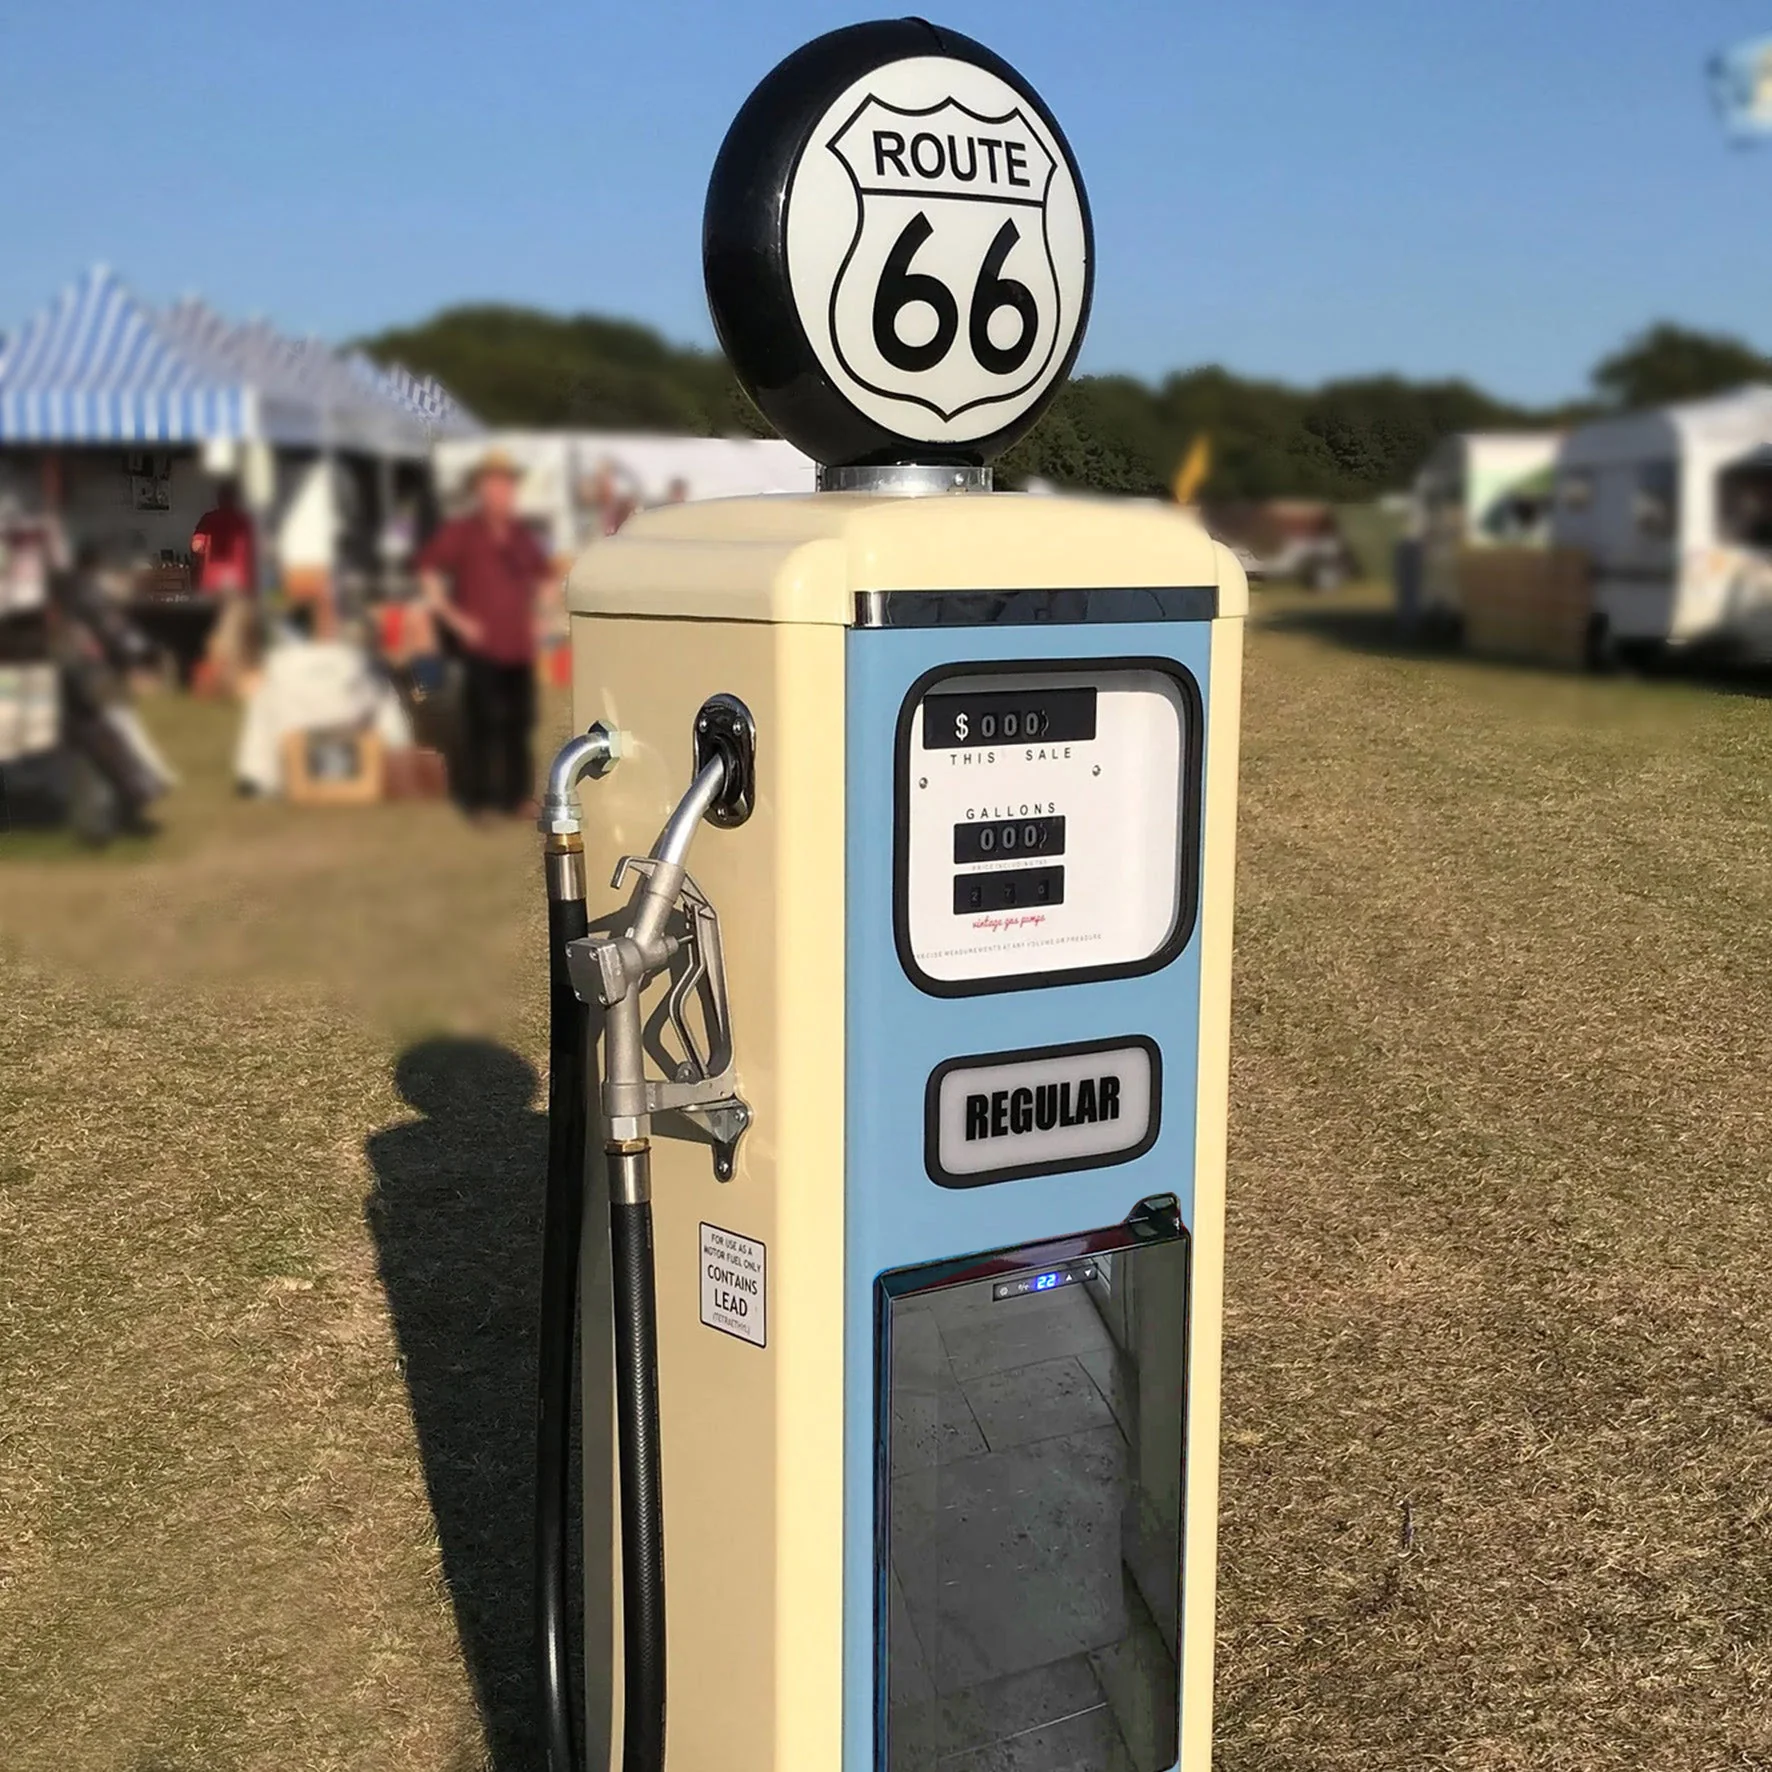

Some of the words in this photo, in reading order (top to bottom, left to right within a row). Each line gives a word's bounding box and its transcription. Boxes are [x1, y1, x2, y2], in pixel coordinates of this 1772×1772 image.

[872, 130, 1031, 188] ROUTE
[872, 211, 1039, 376] 66
[950, 751, 996, 766] THIS
[1025, 746, 1072, 761] SALE
[966, 802, 1056, 820] GALLONS
[965, 1075, 1121, 1142] REGULAR
[704, 1244, 725, 1261] MOTOR
[726, 1252, 743, 1268] FUEL
[743, 1259, 761, 1273] ONLY
[711, 1232, 724, 1246] FOR
[725, 1238, 738, 1252] USE
[738, 1243, 747, 1255] AS
[748, 1247, 753, 1256] A
[707, 1264, 758, 1296] CONTAINS
[1037, 1273, 1056, 1290] 22
[714, 1287, 748, 1317] LEAD
